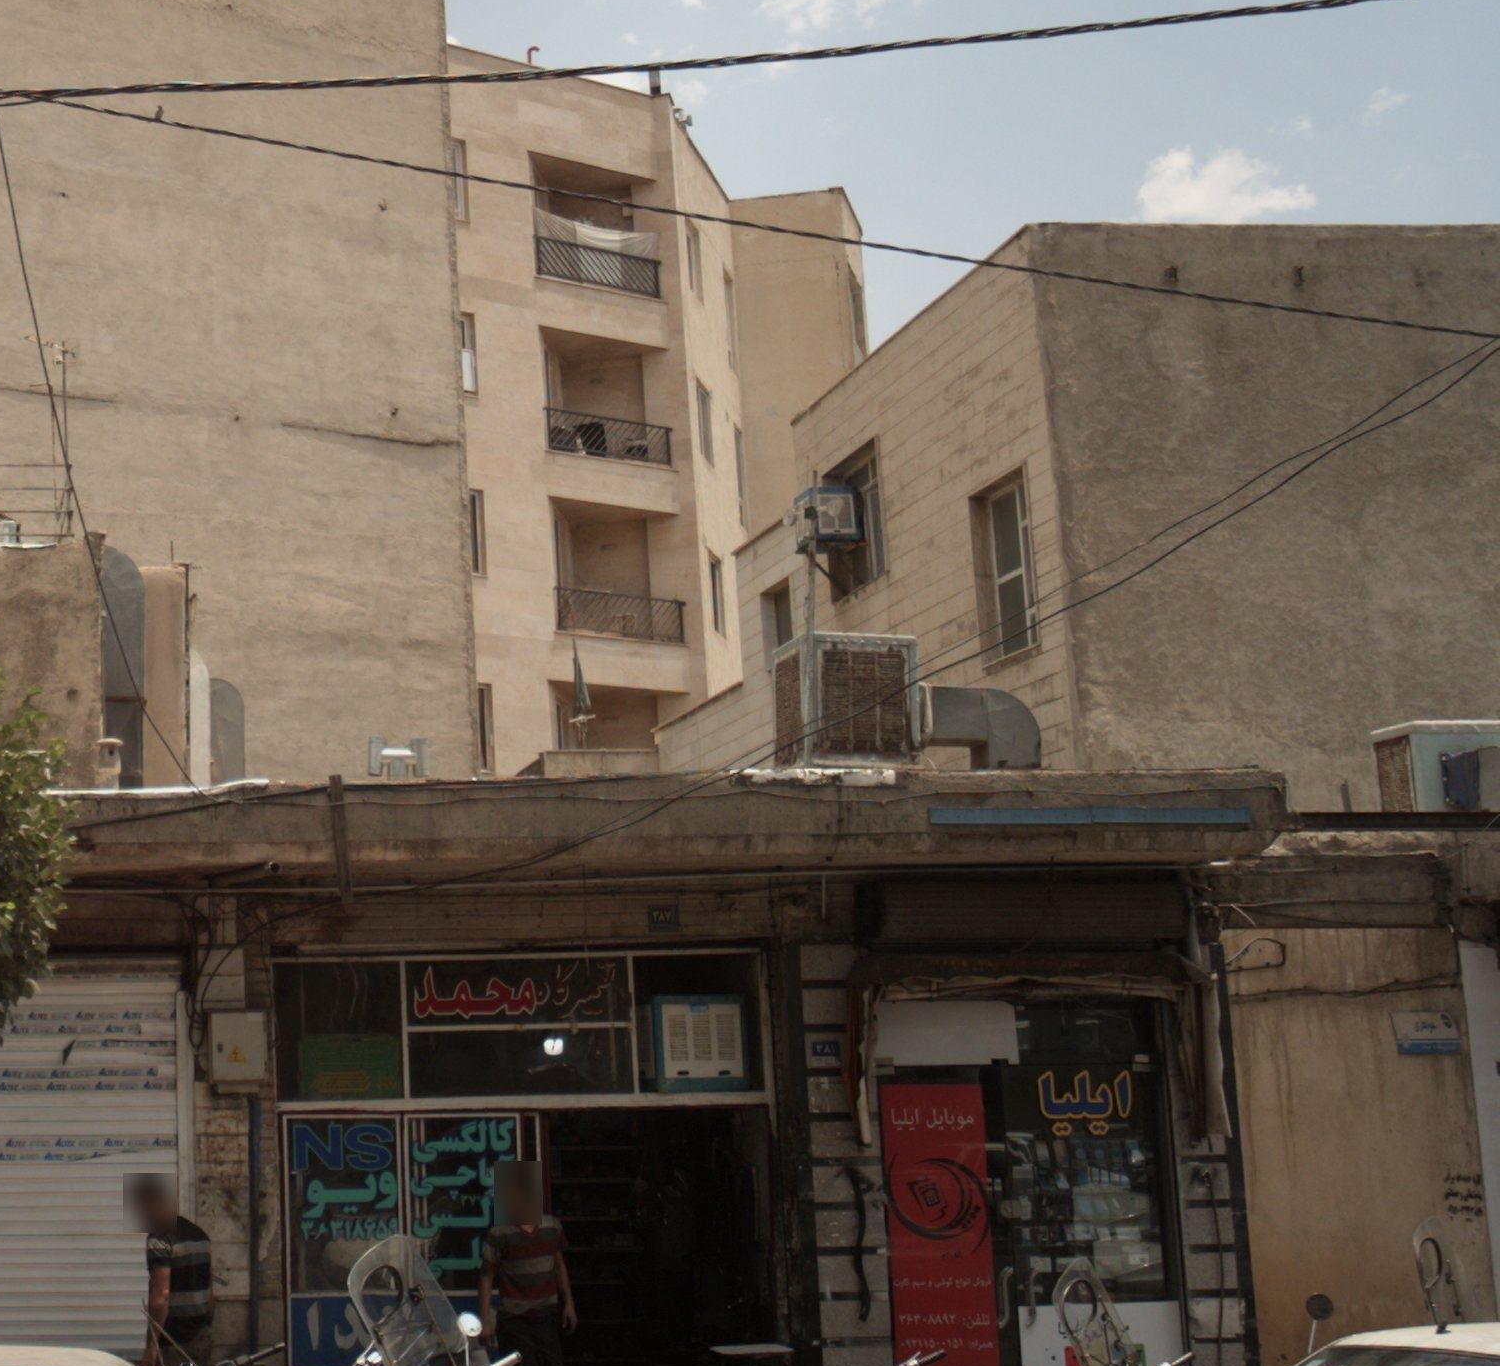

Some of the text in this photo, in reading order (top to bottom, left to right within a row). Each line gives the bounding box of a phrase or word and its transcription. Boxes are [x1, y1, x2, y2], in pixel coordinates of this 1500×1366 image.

[413, 964, 536, 1019] محمد
[891, 1107, 975, 1130] موبایل ایلیا
[1037, 1069, 1132, 1137] ایلیا
[292, 1123, 394, 1171] NS
[302, 1171, 398, 1218] ویو
